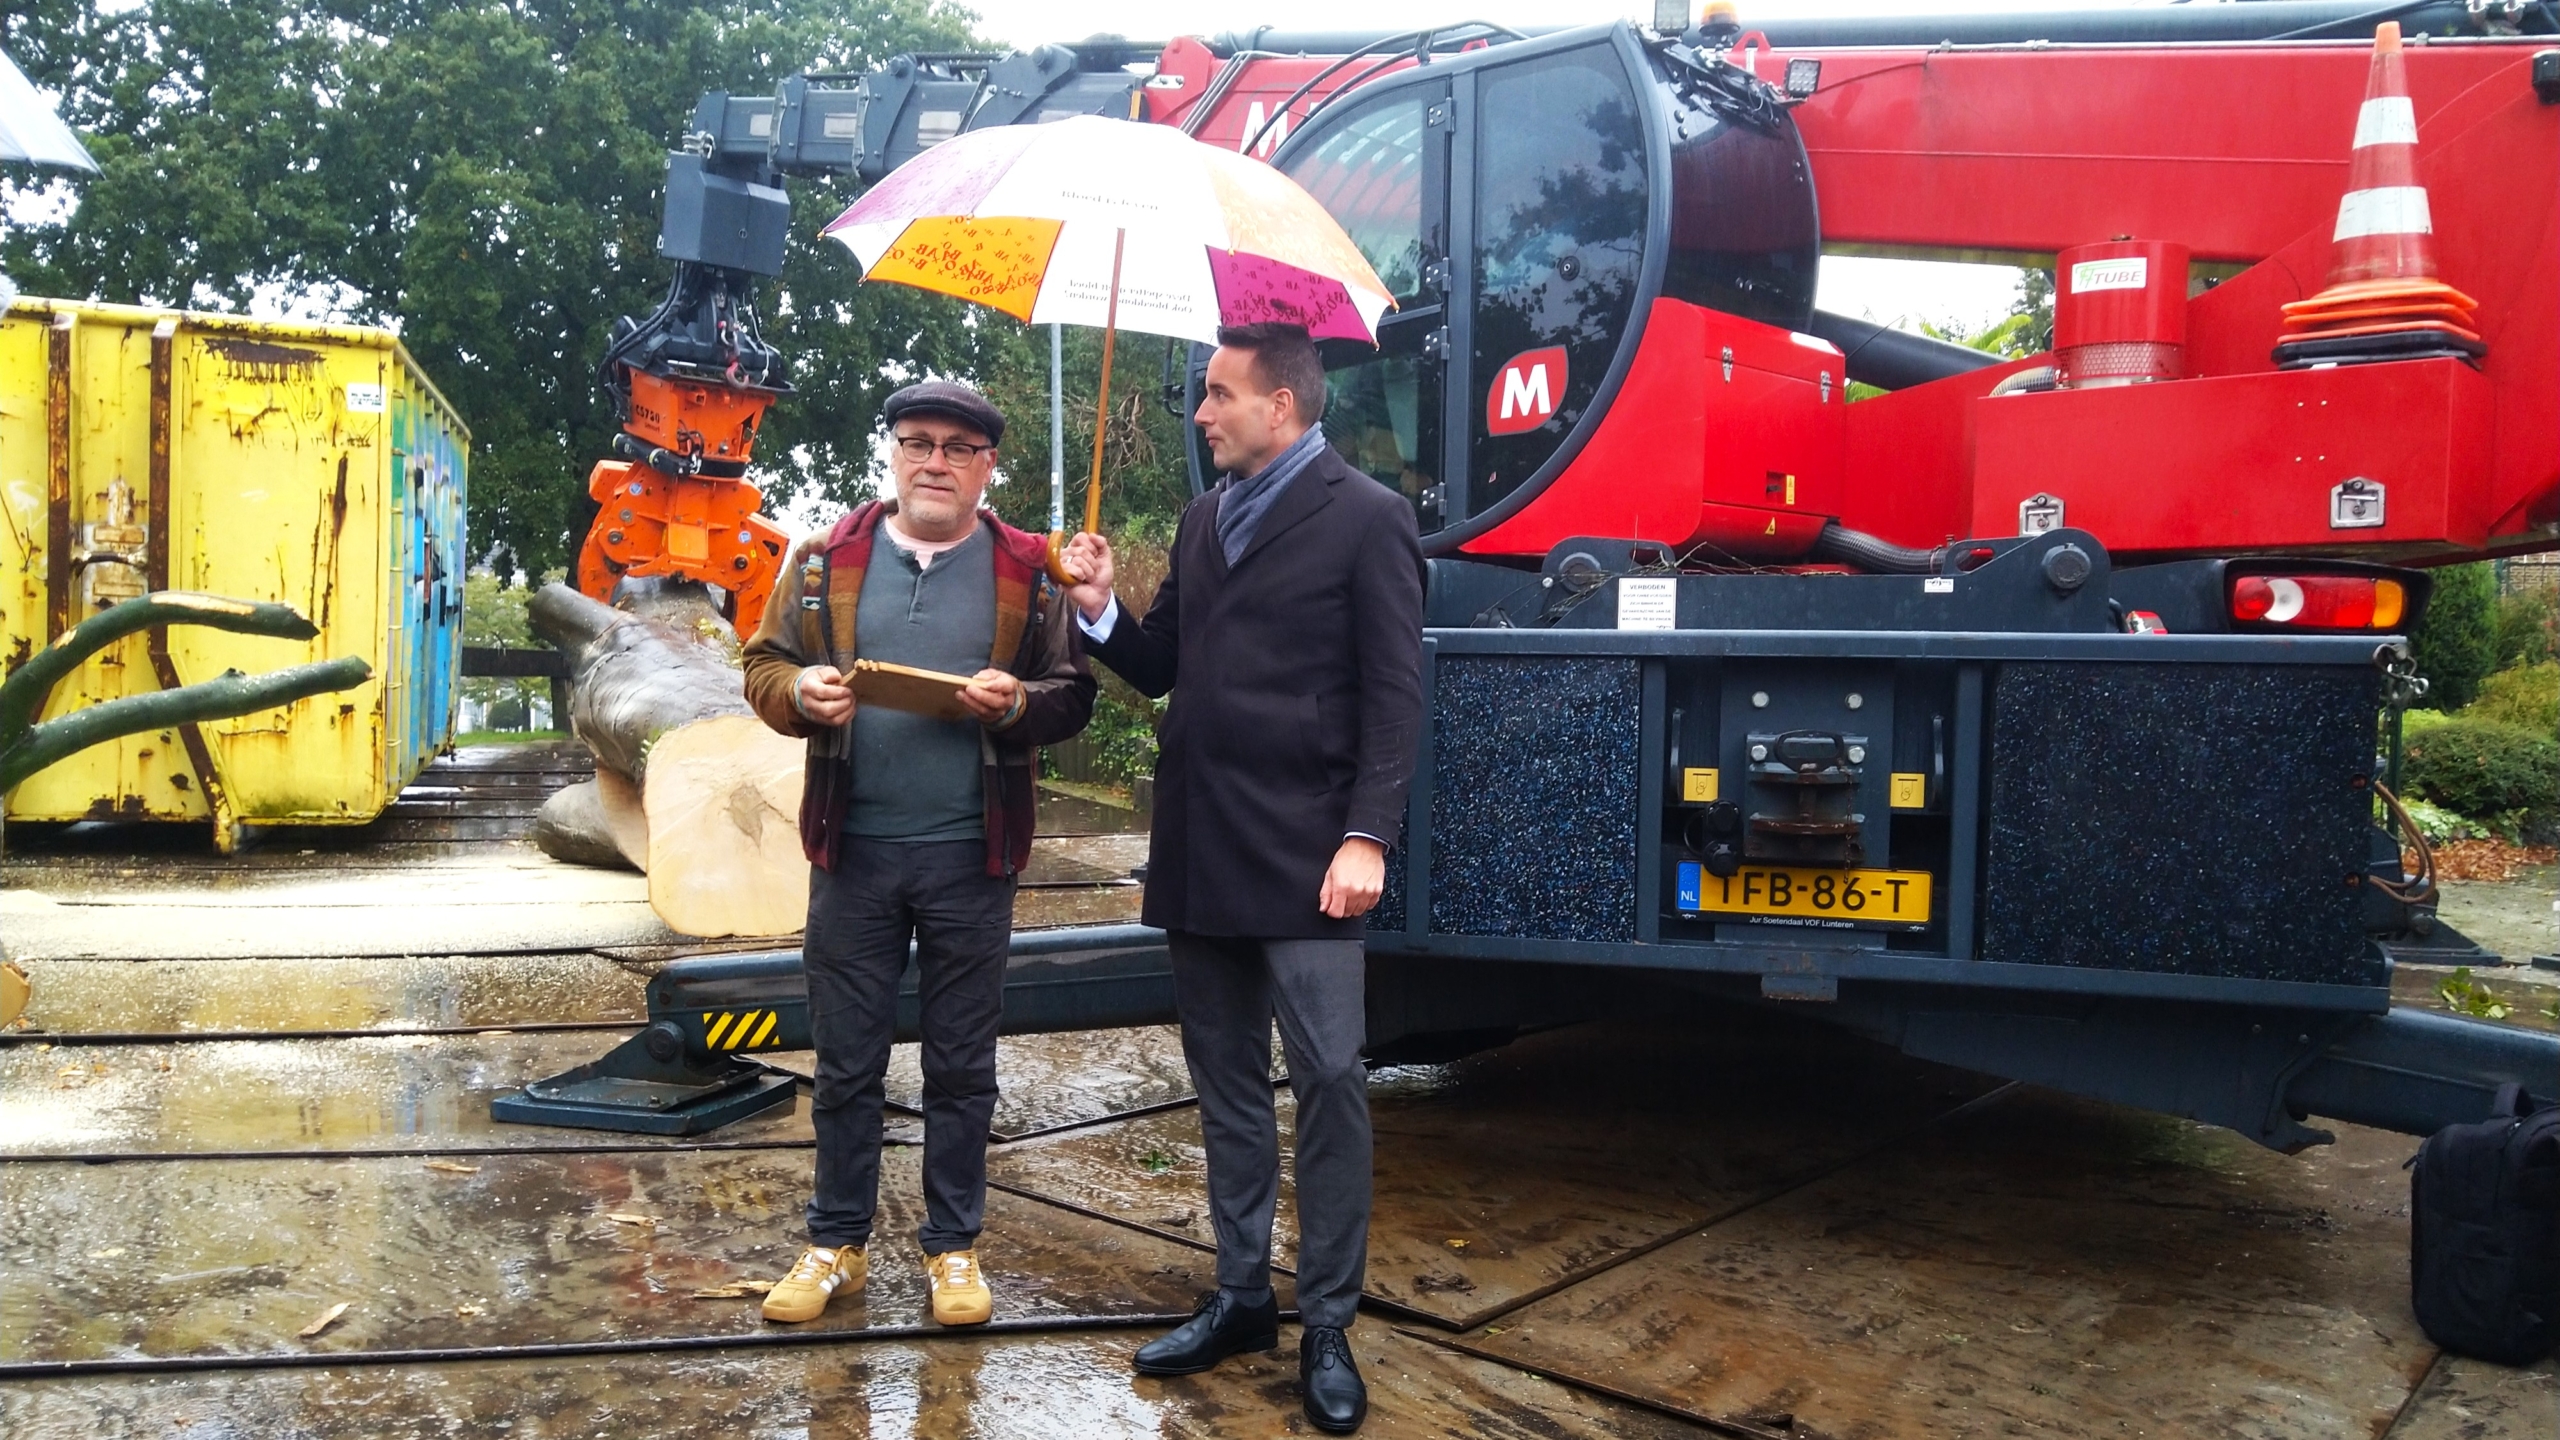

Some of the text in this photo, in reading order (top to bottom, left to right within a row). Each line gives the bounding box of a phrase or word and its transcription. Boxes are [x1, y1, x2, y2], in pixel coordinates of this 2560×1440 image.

[1500, 363, 1551, 419] M
[1680, 890, 1697, 902] NL
[1763, 917, 1803, 926] Soetendaal
[1804, 918, 1821, 927] VOF
[1821, 920, 1854, 929] Lunteren
